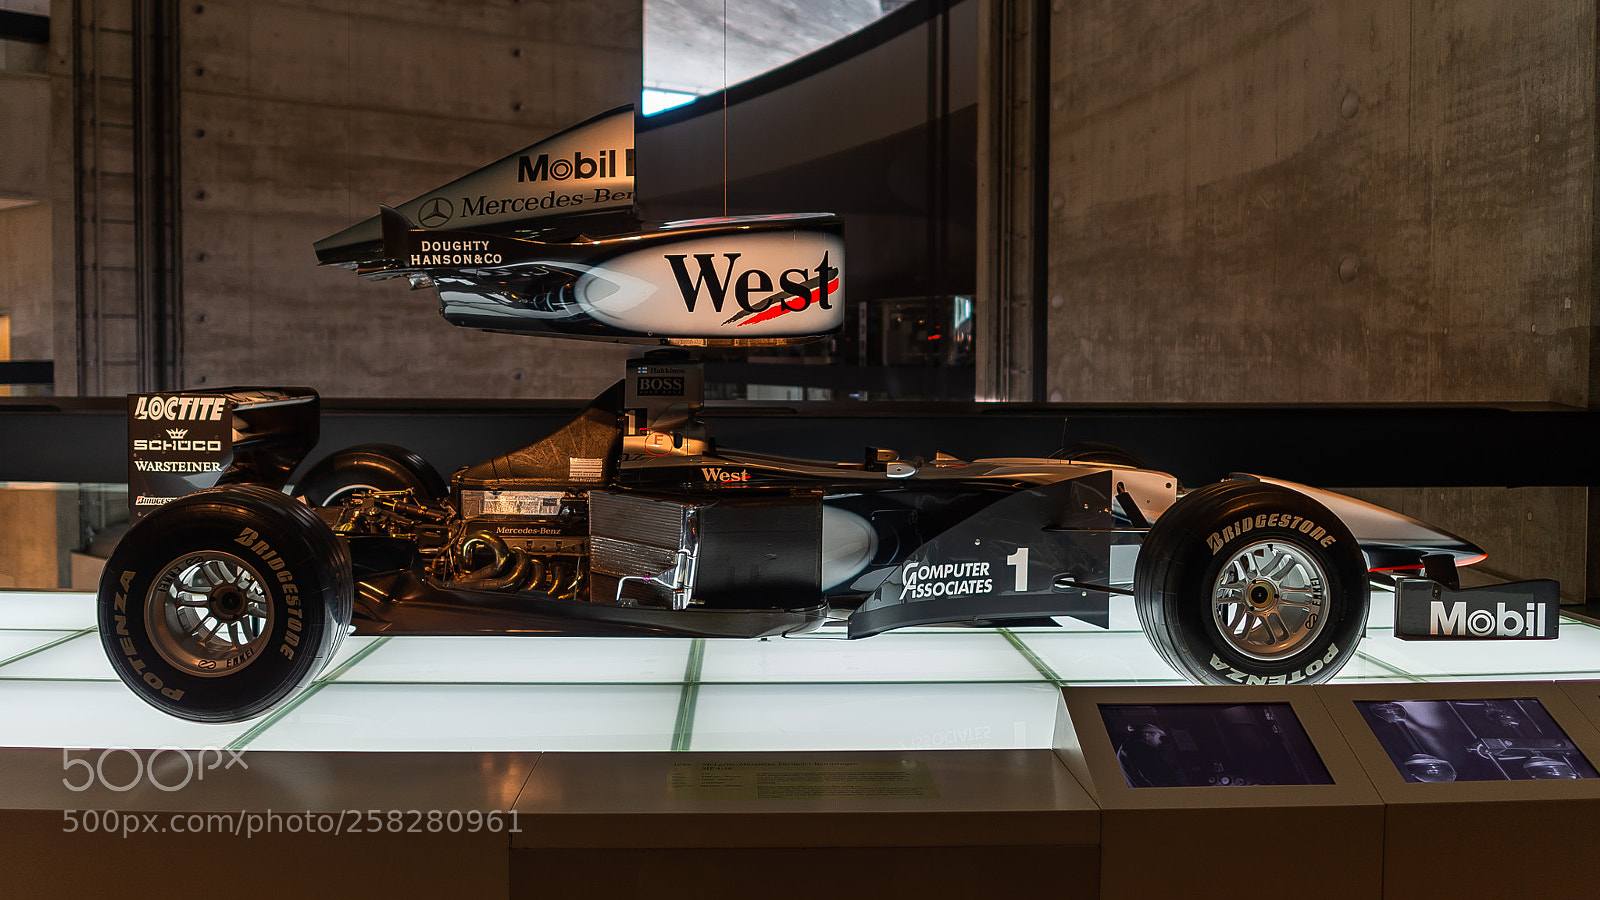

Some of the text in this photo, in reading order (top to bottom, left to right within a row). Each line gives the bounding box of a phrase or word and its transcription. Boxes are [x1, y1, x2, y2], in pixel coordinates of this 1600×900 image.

[518, 149, 616, 183] Mobil
[421, 241, 489, 252] DOUGHTY
[664, 250, 836, 313] West
[640, 378, 682, 390] BOSS
[134, 397, 226, 421] LOCTITE
[134, 461, 222, 472] WARSTEINER
[701, 467, 748, 483] West
[496, 526, 561, 535] Mercedes-Benz
[1206, 513, 1336, 556] BRIDGESTONE
[902, 562, 990, 586] COMPUTER
[1006, 547, 1029, 592] 1
[234, 526, 303, 661] BRIDGESTONE
[899, 572, 993, 600] ASSOCIATES
[1430, 601, 1546, 637] Mobil
[113, 570, 185, 701] POTENZA
[1209, 642, 1339, 686] POTENZA
